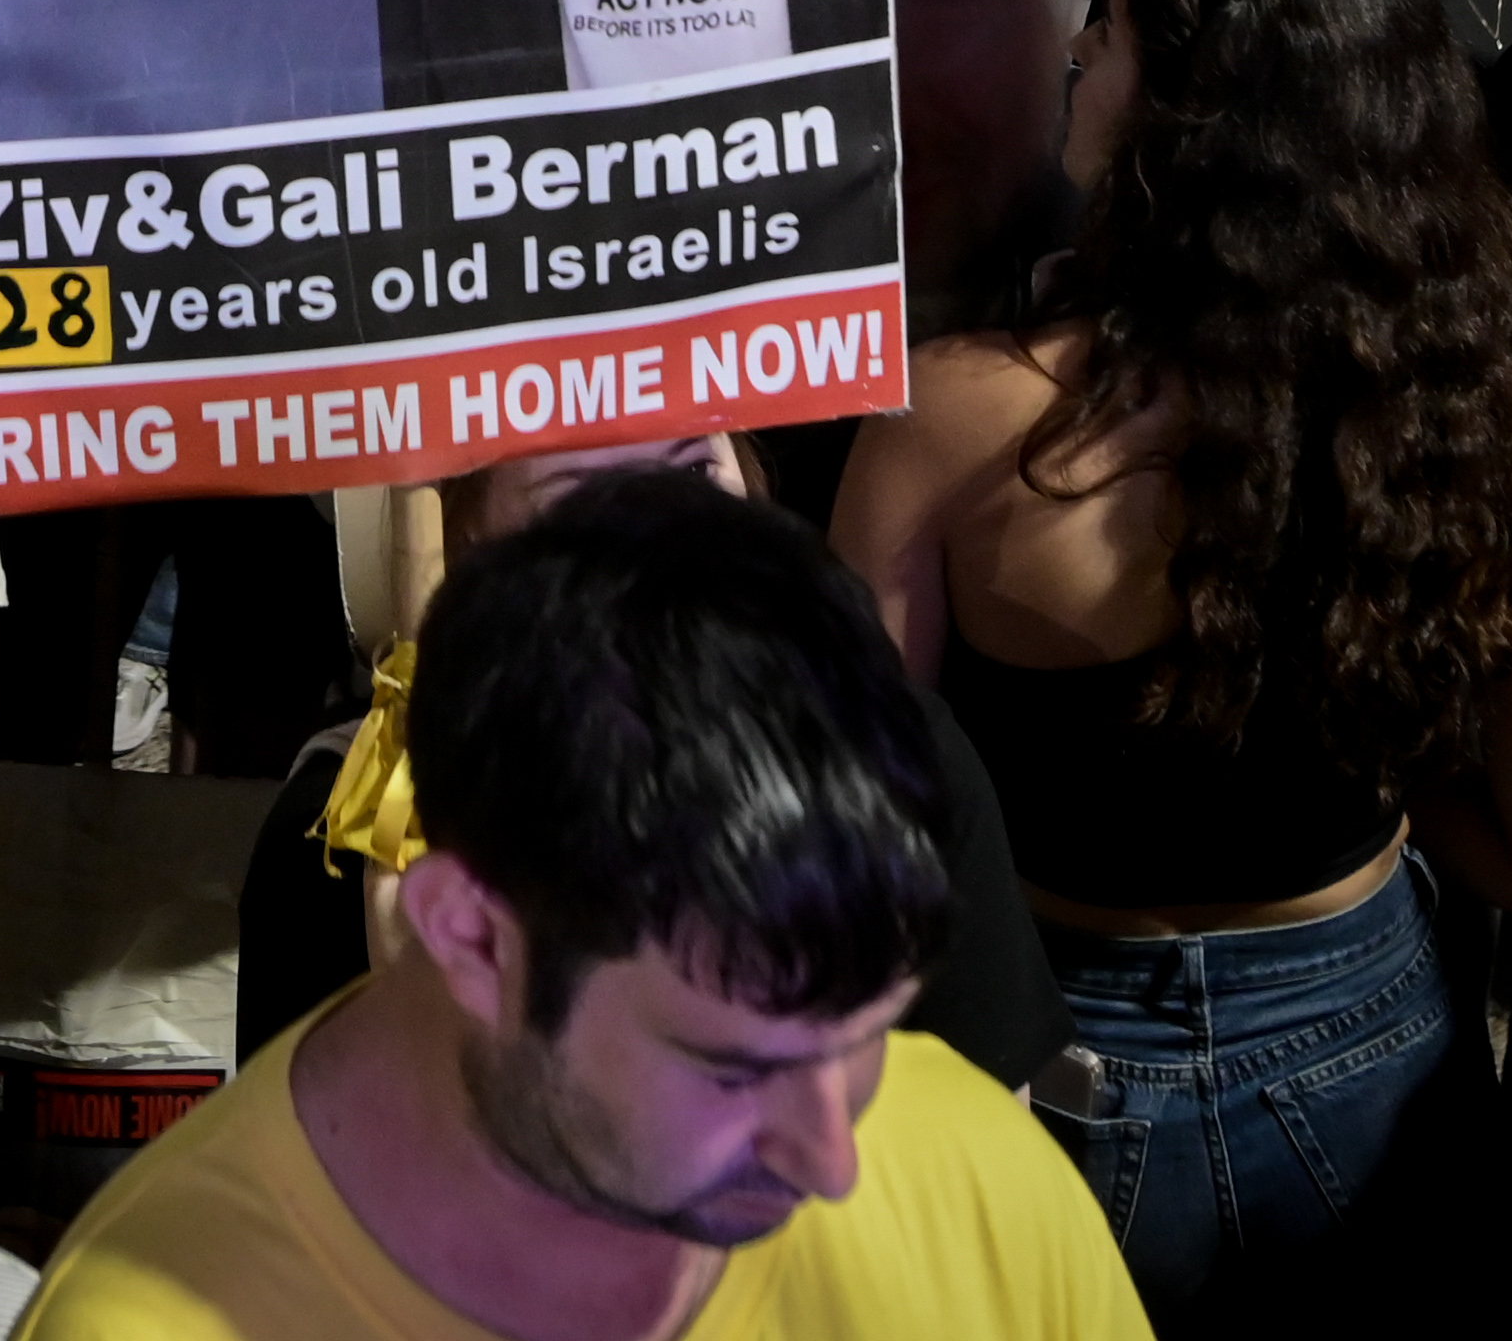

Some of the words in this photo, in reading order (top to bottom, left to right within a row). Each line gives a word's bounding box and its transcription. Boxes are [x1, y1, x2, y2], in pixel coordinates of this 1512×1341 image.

[573, 14, 643, 38] BEFORE
[647, 20, 676, 37] ITS
[682, 12, 721, 33] TOO
[449, 102, 840, 223] Berman
[121, 274, 337, 352] years
[371, 248, 489, 311] old
[521, 205, 804, 297] Israelis
[203, 382, 421, 466] THEM
[449, 345, 664, 444] HOME
[690, 307, 886, 406] NOW!
